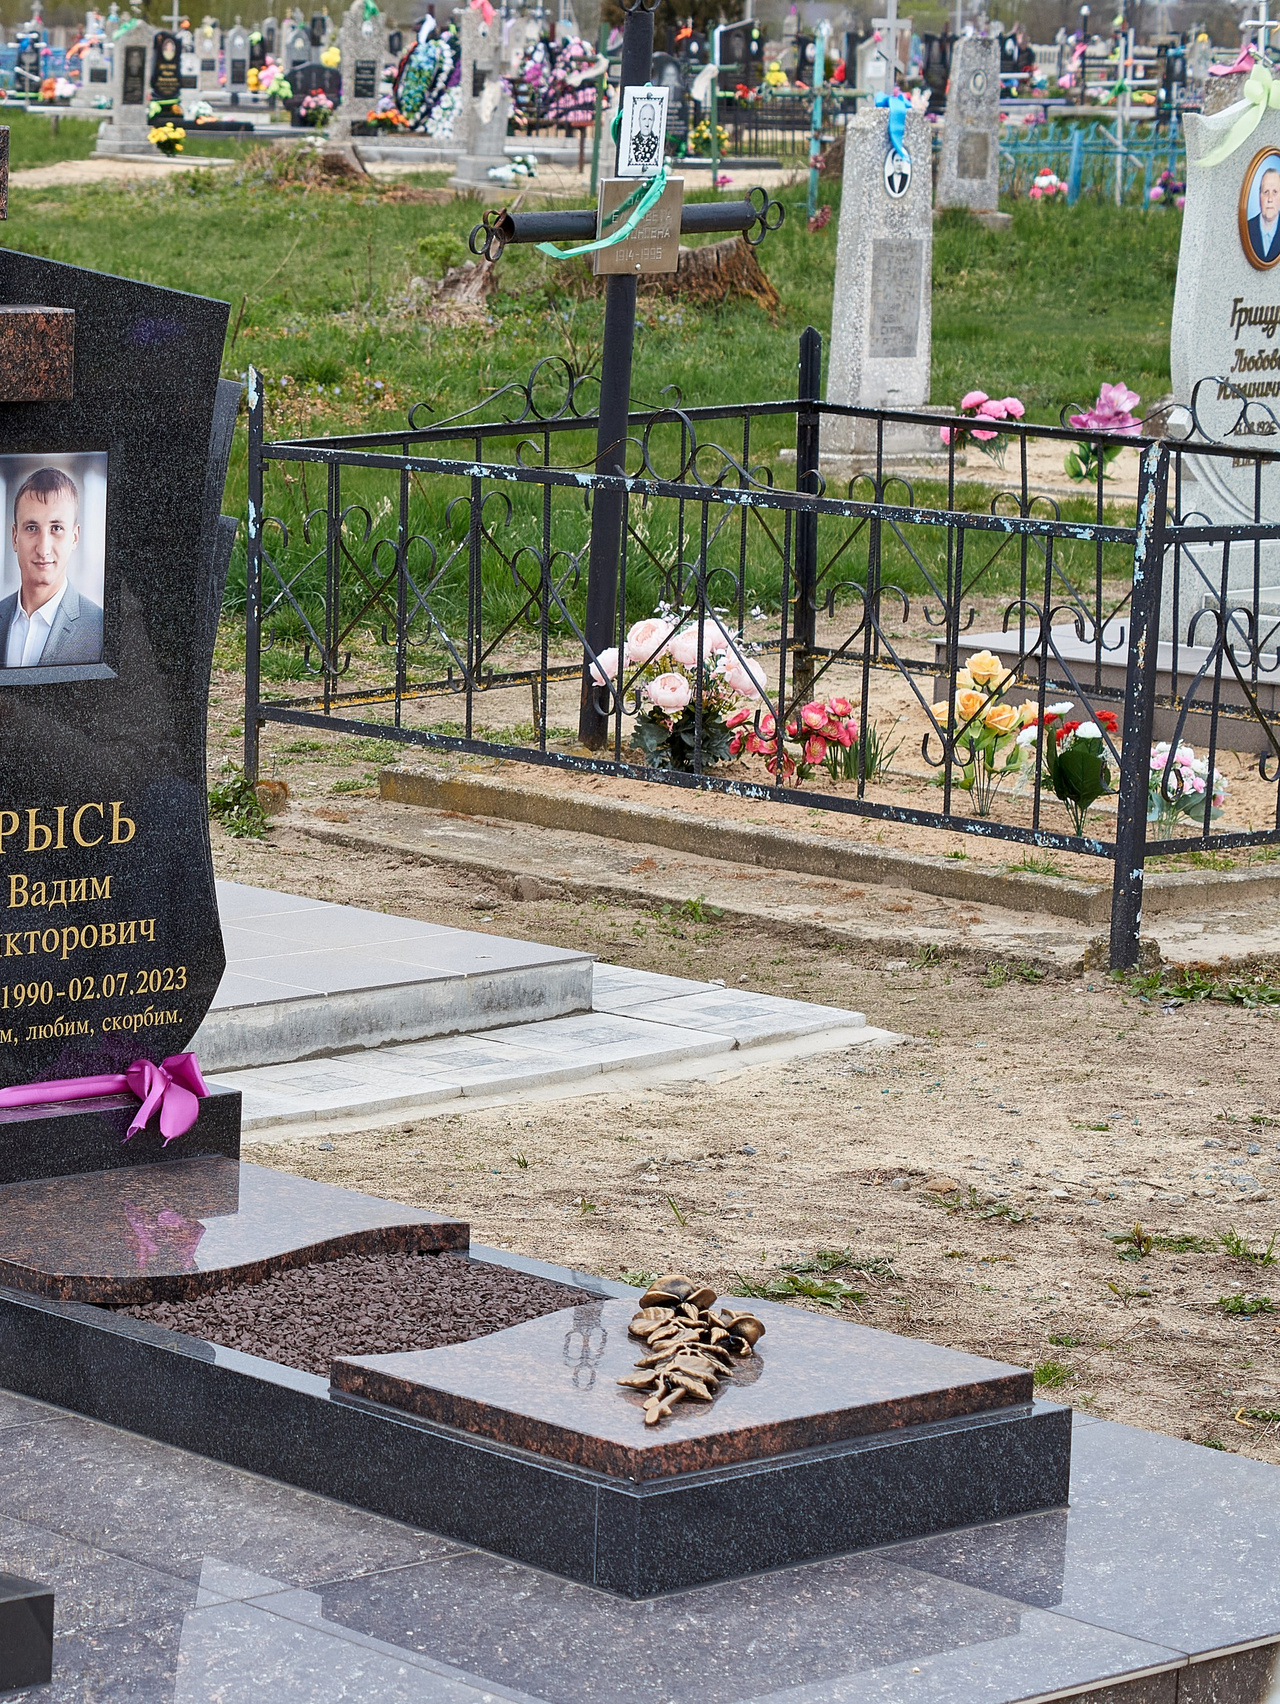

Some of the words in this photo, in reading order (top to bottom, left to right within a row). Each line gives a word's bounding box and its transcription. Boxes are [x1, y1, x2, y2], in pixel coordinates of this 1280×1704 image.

[1230, 348, 1280, 373] Любов
[7, 875, 114, 912] Вадим
[25, 1018, 95, 1041] любим,
[102, 1004, 184, 1033] скорбим.
